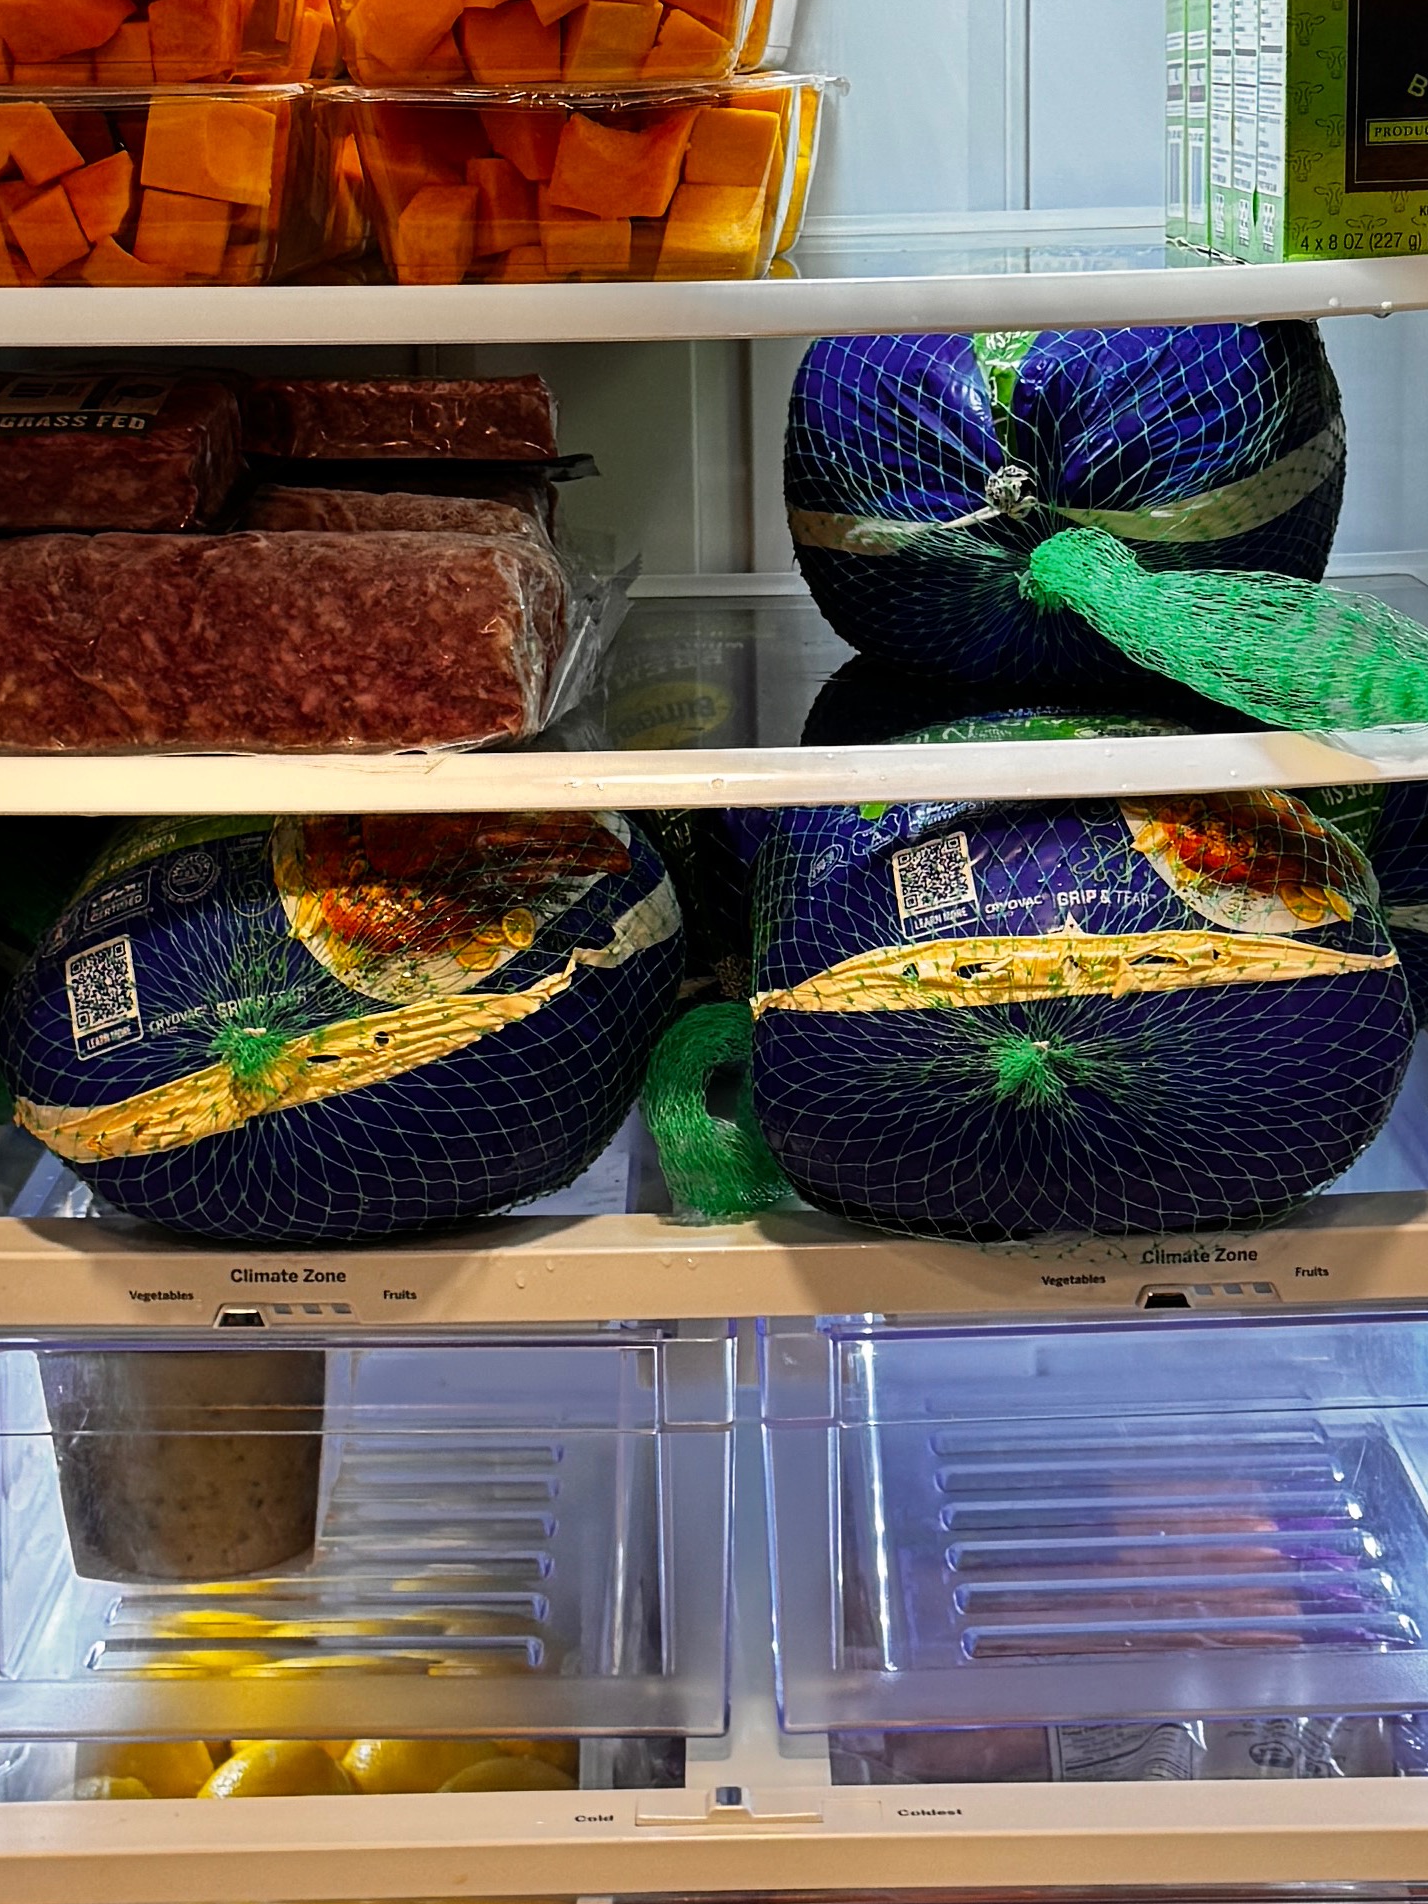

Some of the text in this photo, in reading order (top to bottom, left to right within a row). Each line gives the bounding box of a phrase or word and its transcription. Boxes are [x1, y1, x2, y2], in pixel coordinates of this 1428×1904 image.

[1299, 237, 1309, 251] 4
[1315, 240, 1323, 250] x
[1328, 235, 1337, 250] 8
[1343, 233, 1364, 250] OZ
[1369, 231, 1403, 252] (227
[1408, 230, 1422, 253] g)
[0, 415, 146, 430] GRASS FED
[1057, 890, 1096, 908] GRIP
[1100, 889, 1111, 905] &
[913, 906, 969, 930] LEARN MORE
[85, 1032, 110, 1051] LEARN
[1142, 1247, 1258, 1264] Climate Zone
[230, 1268, 346, 1284] Climate Zone
[1042, 1266, 1329, 1287] Vegetables Fruits
[129, 1289, 417, 1302] Vegetables Fruits
[574, 1808, 963, 1823] Cold Coldest
